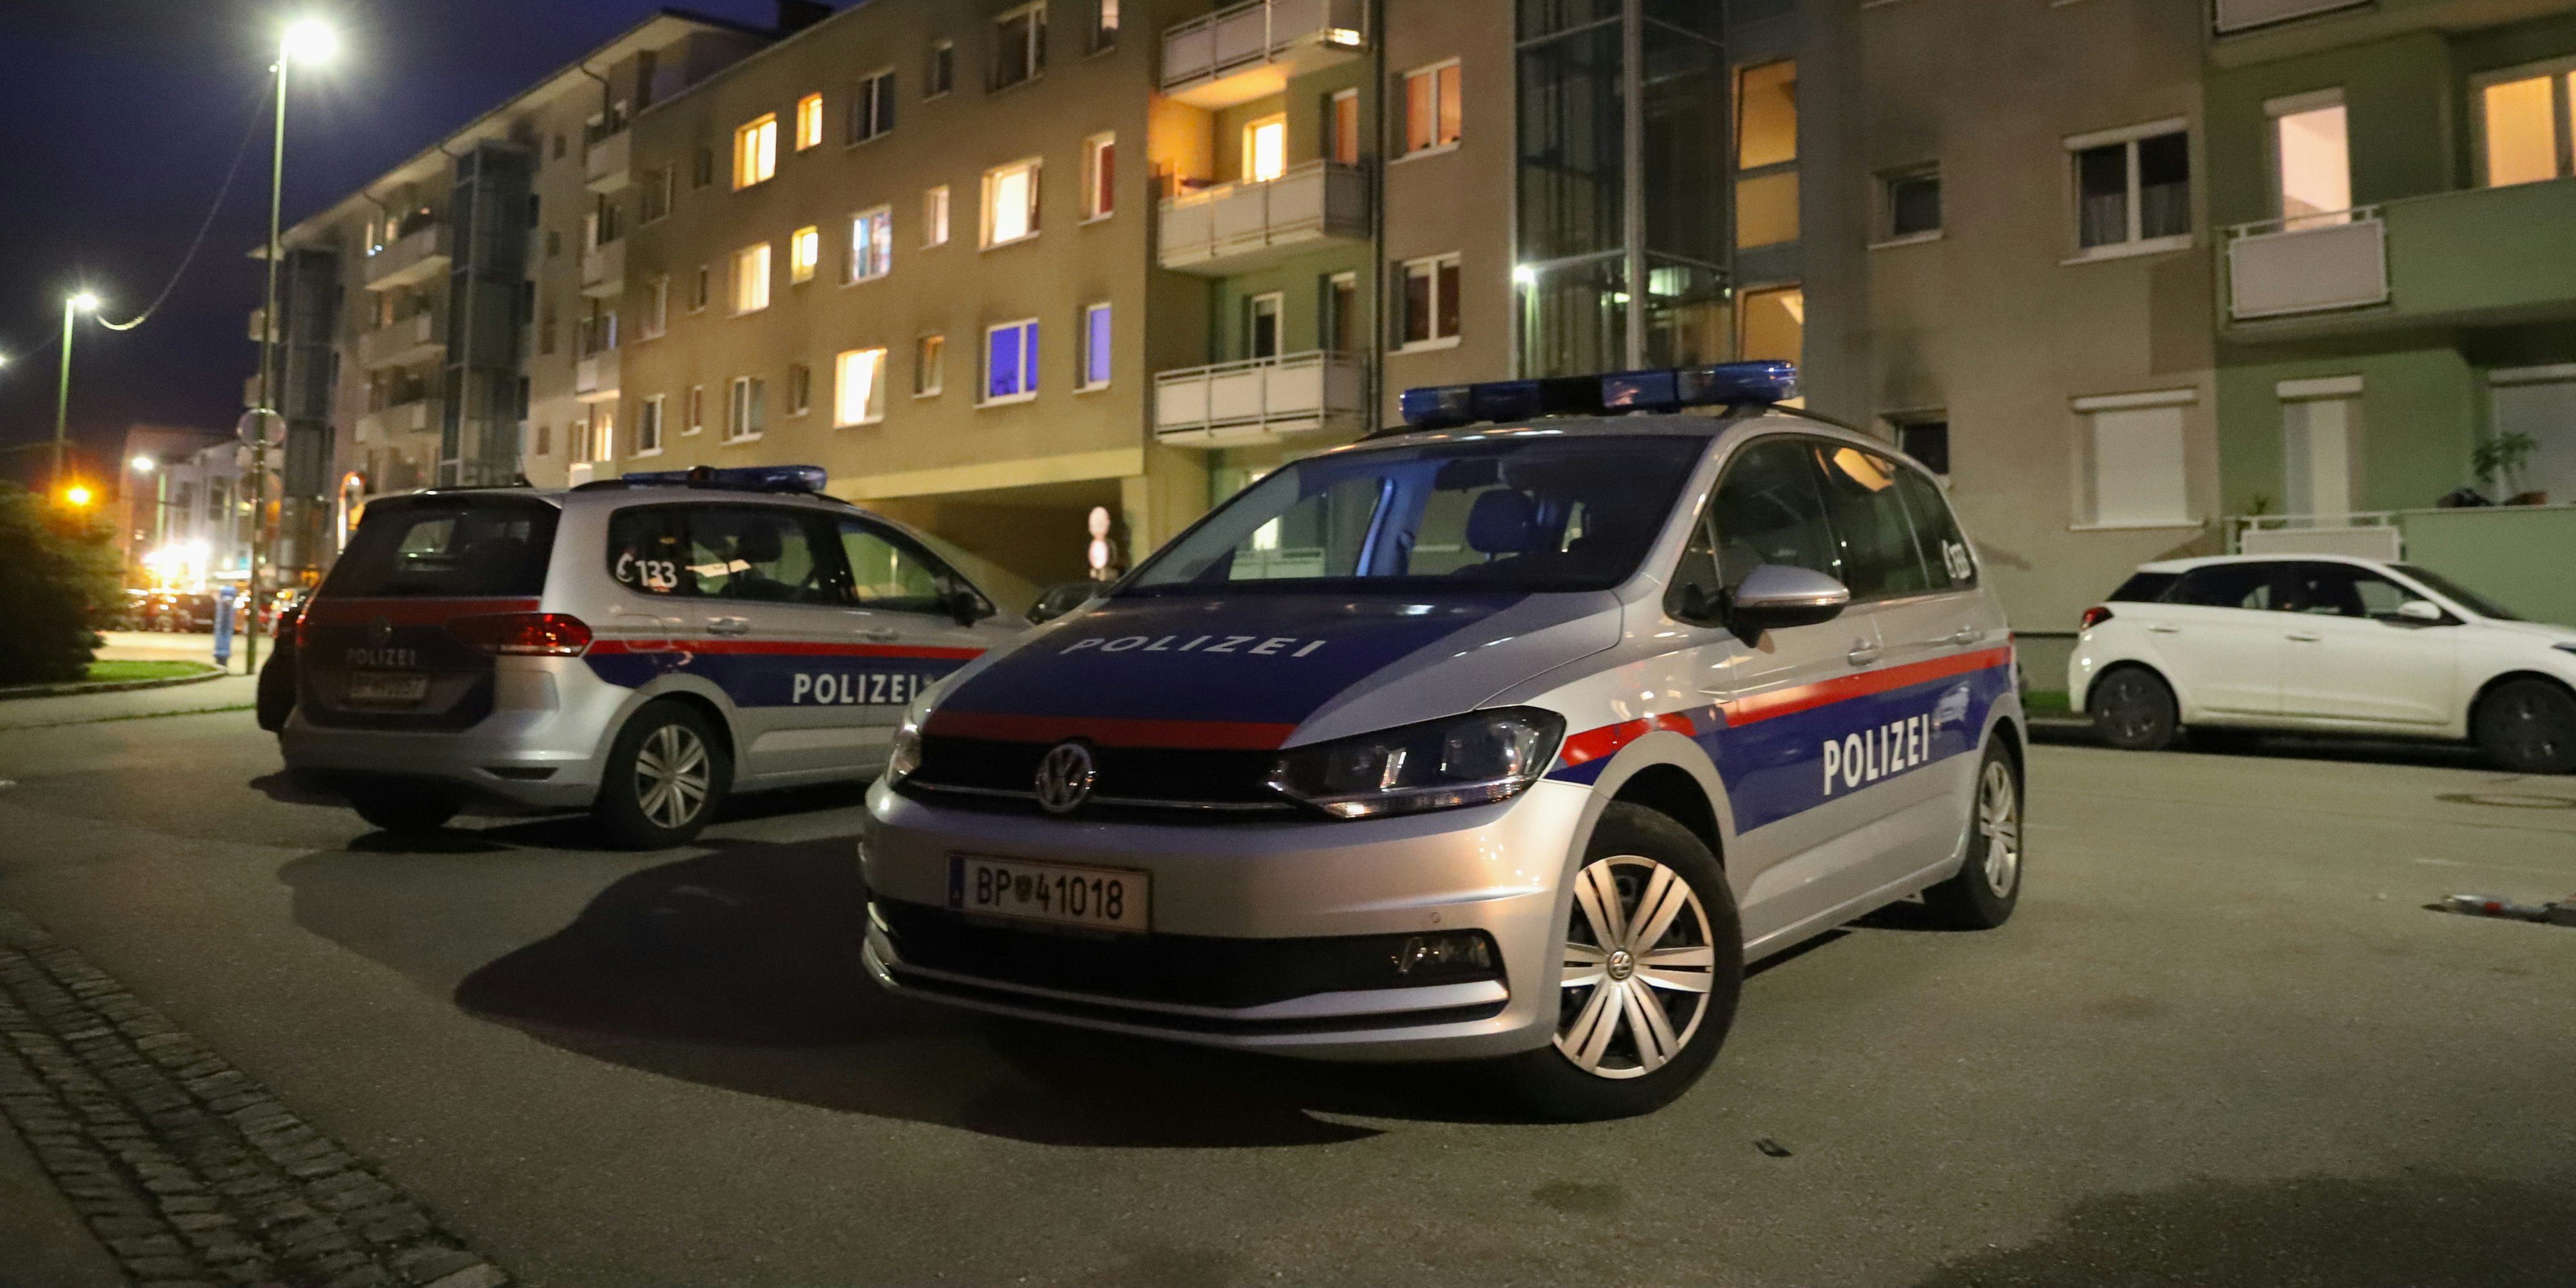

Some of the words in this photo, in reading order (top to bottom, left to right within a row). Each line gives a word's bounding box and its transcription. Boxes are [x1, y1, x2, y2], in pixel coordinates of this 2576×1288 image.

[634, 560, 678, 588] 133
[346, 648, 416, 666] POLIZEI
[1059, 636, 1327, 658] POLIZEI
[793, 673, 917, 704] POLIZEI
[1823, 714, 1929, 796] POLIZEI
[977, 867, 1011, 907] BP
[1036, 873, 1124, 920] 41018
